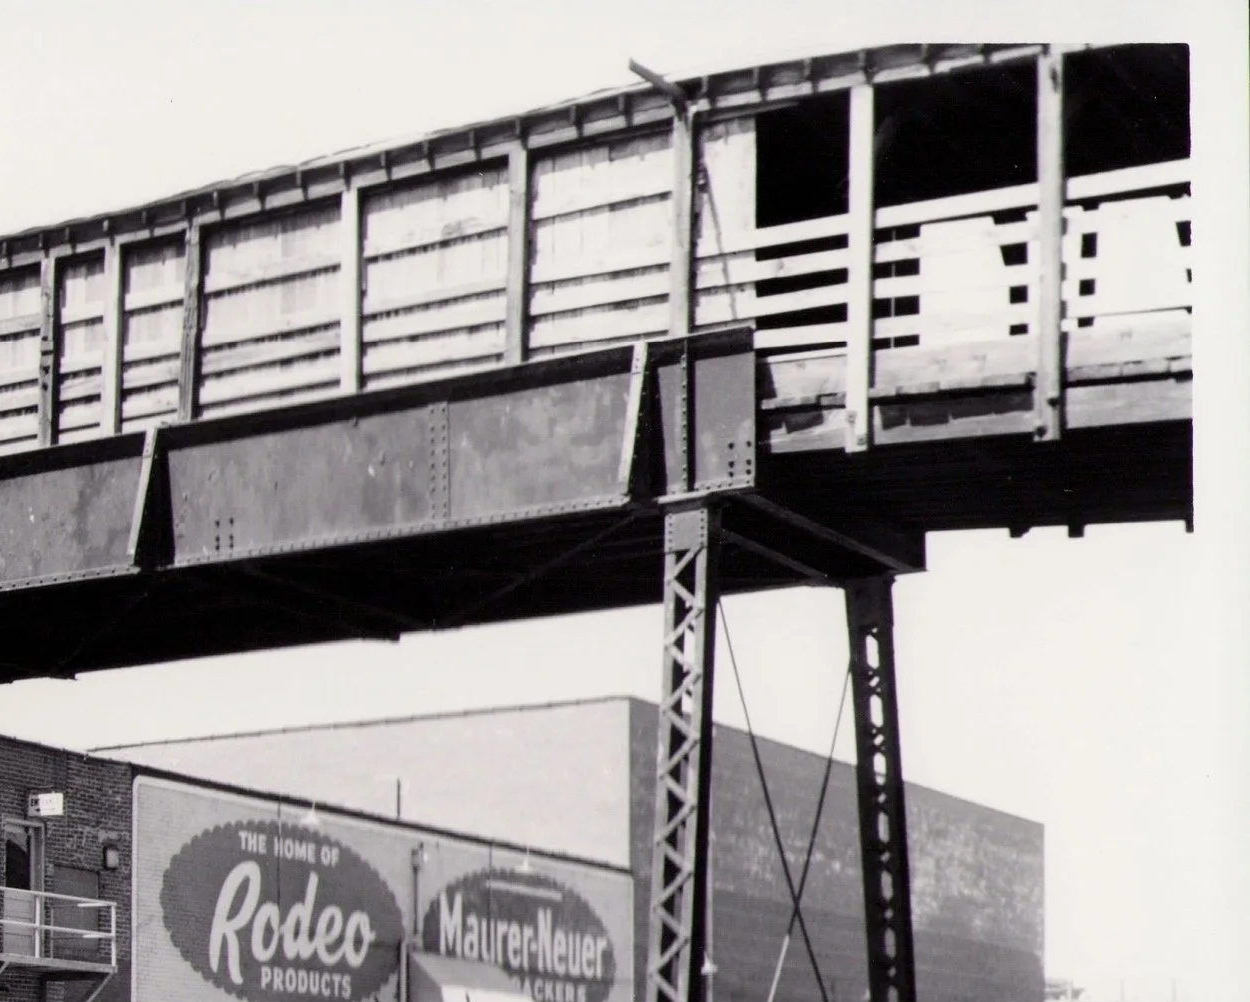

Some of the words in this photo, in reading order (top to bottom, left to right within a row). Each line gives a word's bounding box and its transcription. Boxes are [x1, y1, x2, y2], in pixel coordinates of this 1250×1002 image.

[238, 830, 267, 855] THE
[273, 836, 316, 865] HOME
[320, 844, 340, 868] OF
[209, 860, 376, 985] Rodeo
[440, 892, 607, 980] Maurer-Neuer
[261, 965, 352, 999] PRODUCTS
